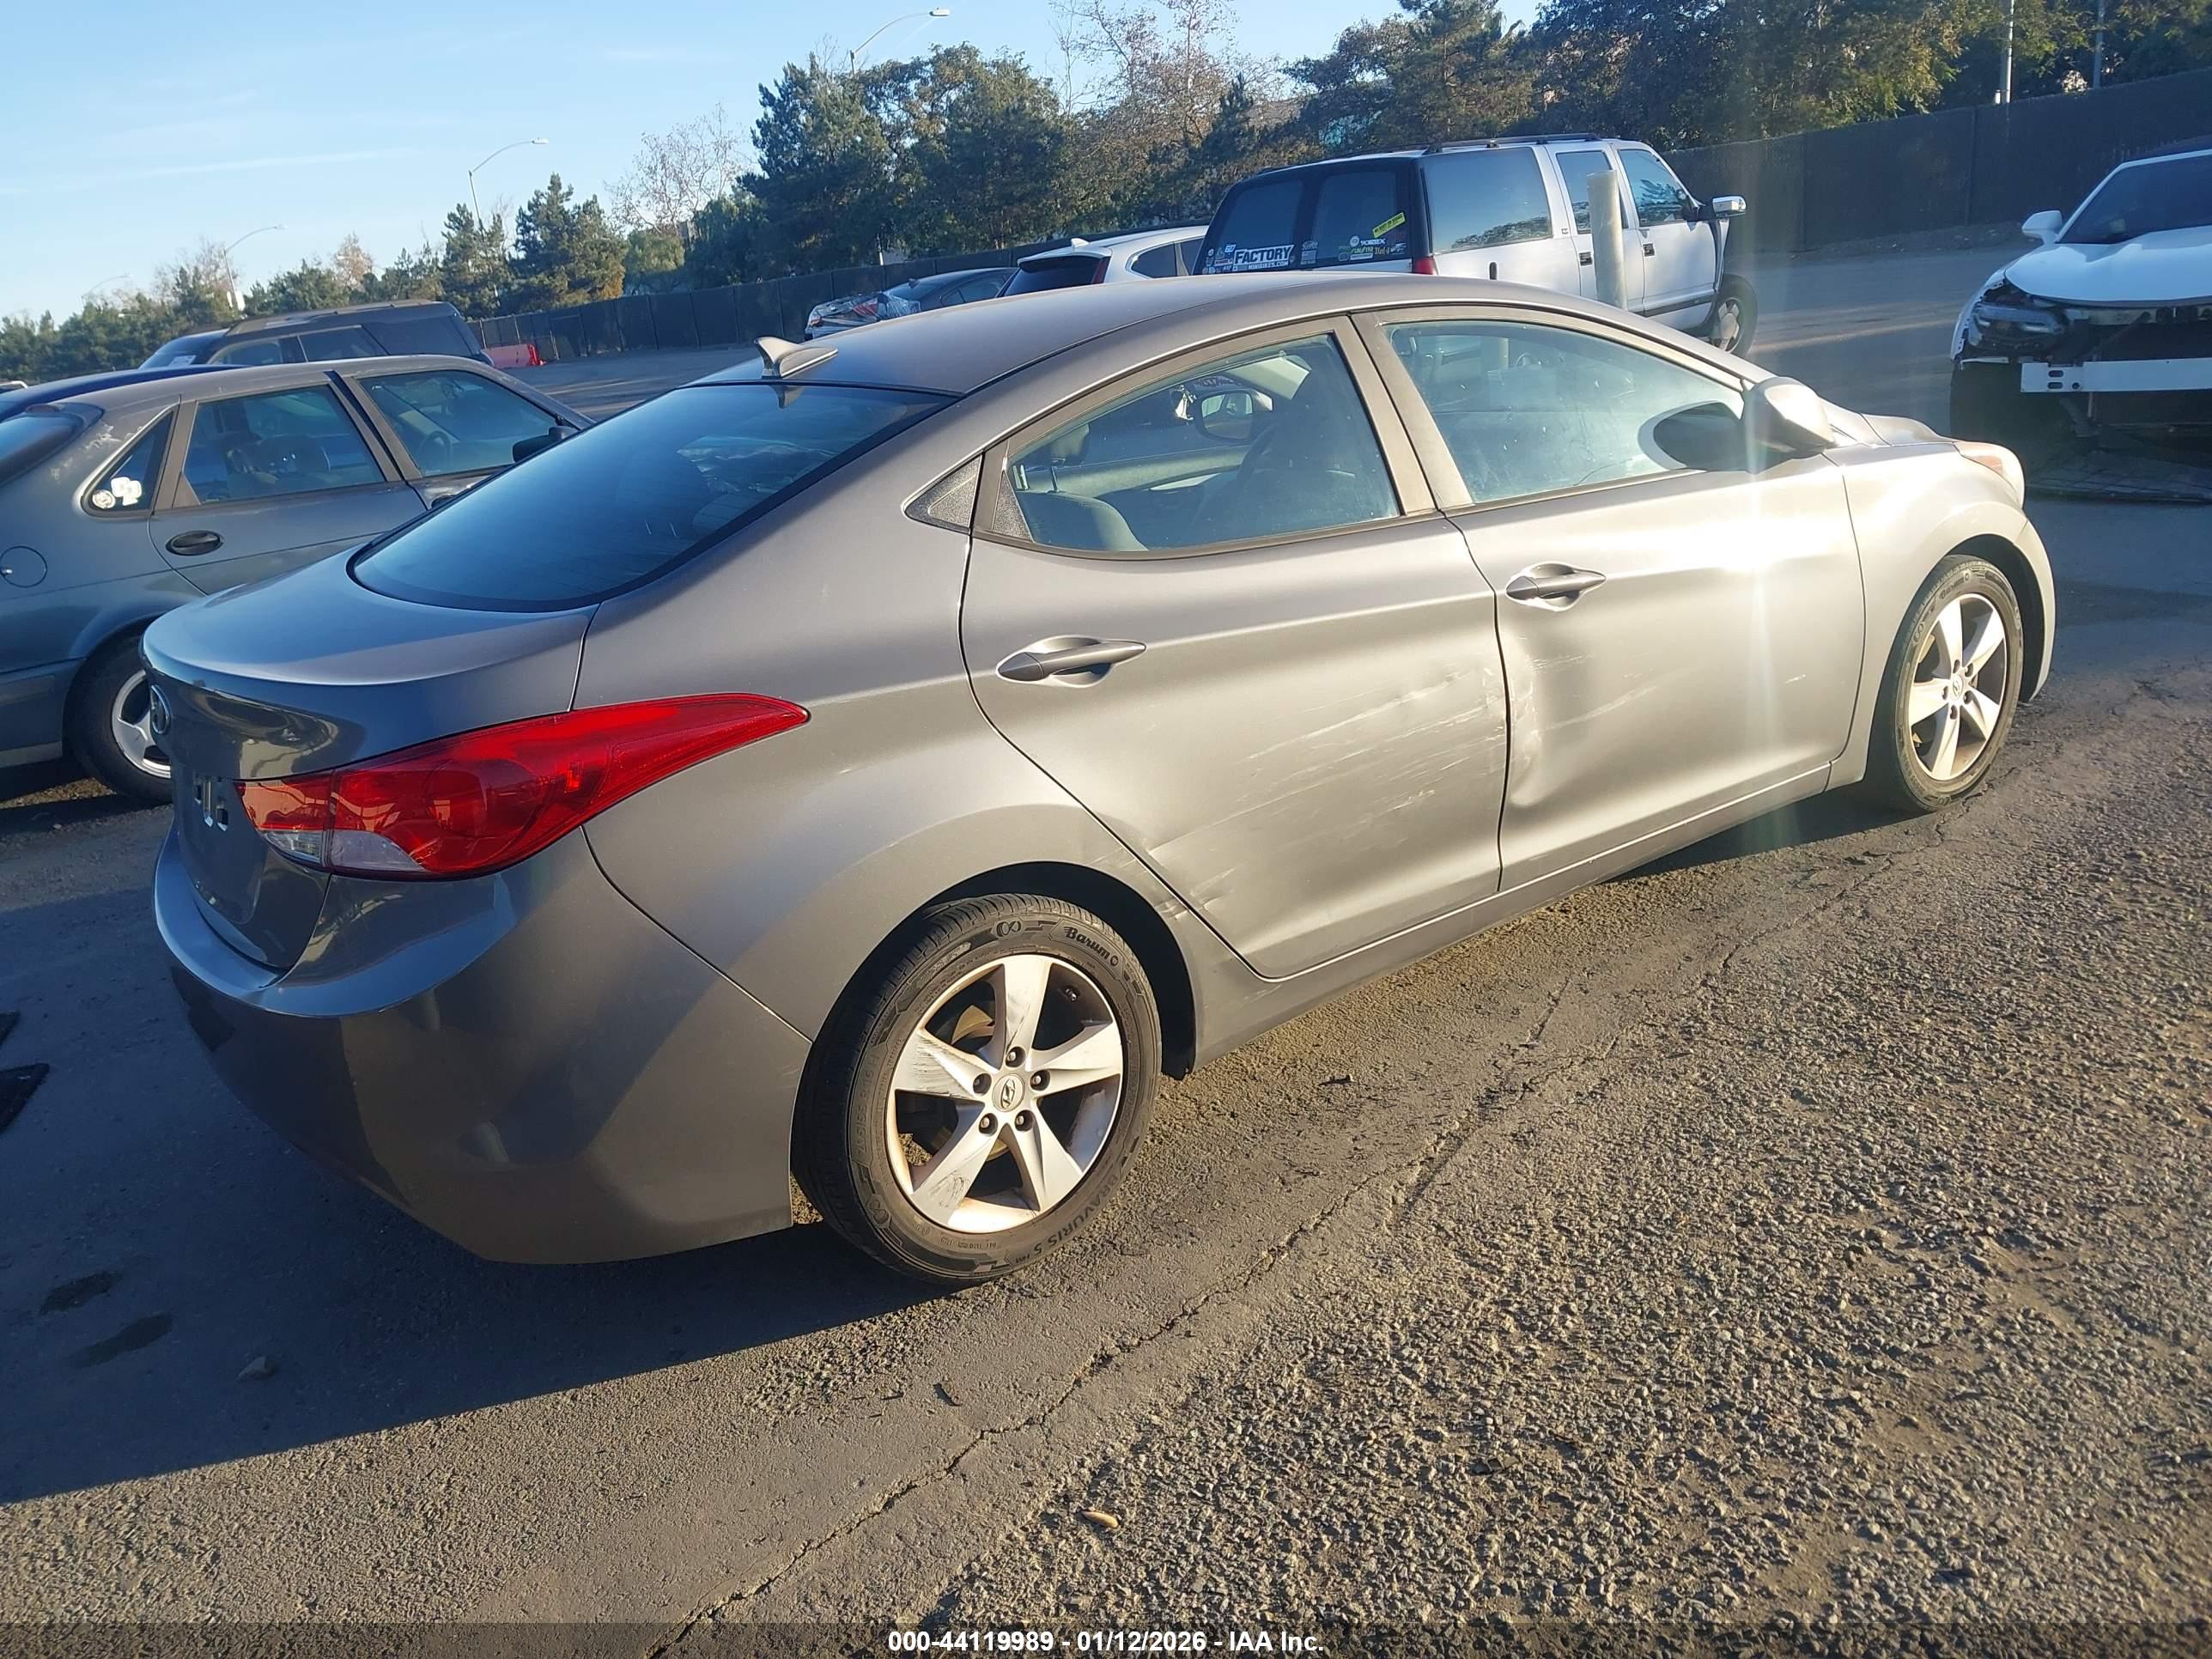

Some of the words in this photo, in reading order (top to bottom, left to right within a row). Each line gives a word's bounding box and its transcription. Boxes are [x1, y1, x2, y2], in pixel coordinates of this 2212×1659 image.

[1235, 246, 1291, 265] FACTORY
[1063, 926, 1111, 961] Barum
[1048, 1175, 1119, 1248] BRAVURIS
